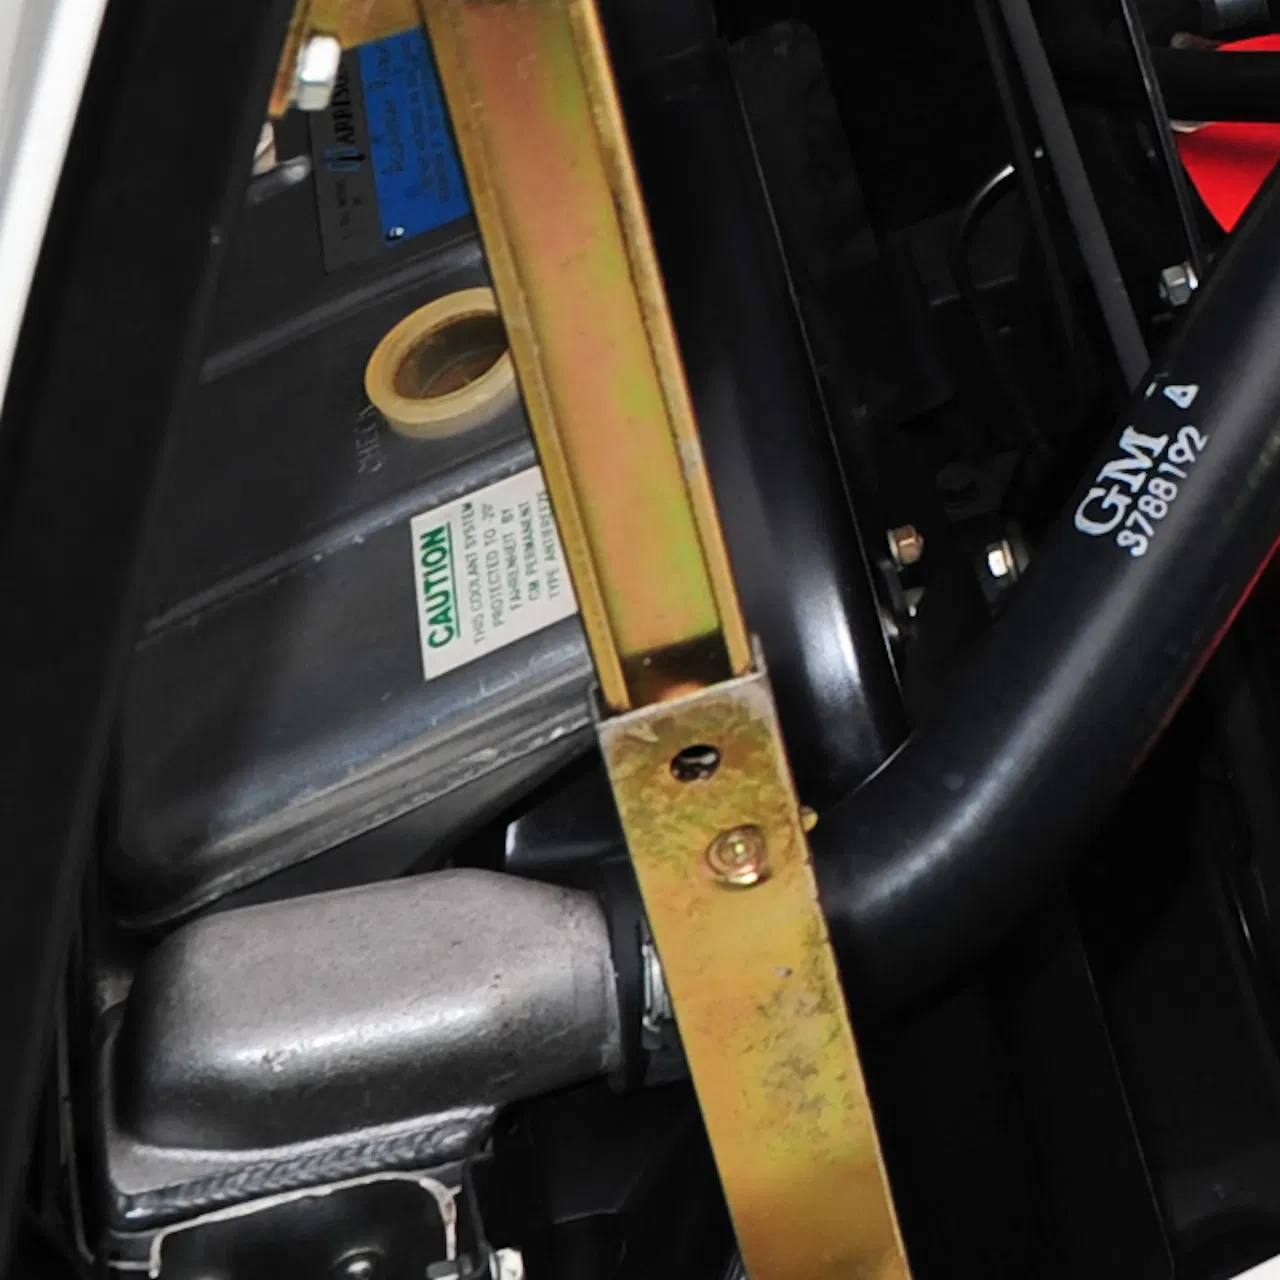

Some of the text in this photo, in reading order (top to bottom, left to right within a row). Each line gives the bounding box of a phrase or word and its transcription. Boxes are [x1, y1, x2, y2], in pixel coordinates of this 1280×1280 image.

[1074, 425, 1169, 536] GM
[1116, 426, 1210, 557] 3788192
[461, 501, 477, 549] SYSTEM
[483, 528, 497, 546] TO
[419, 525, 455, 649] CAUTION
[485, 550, 505, 628] PROTECTED
[472, 613, 486, 645] THIS
